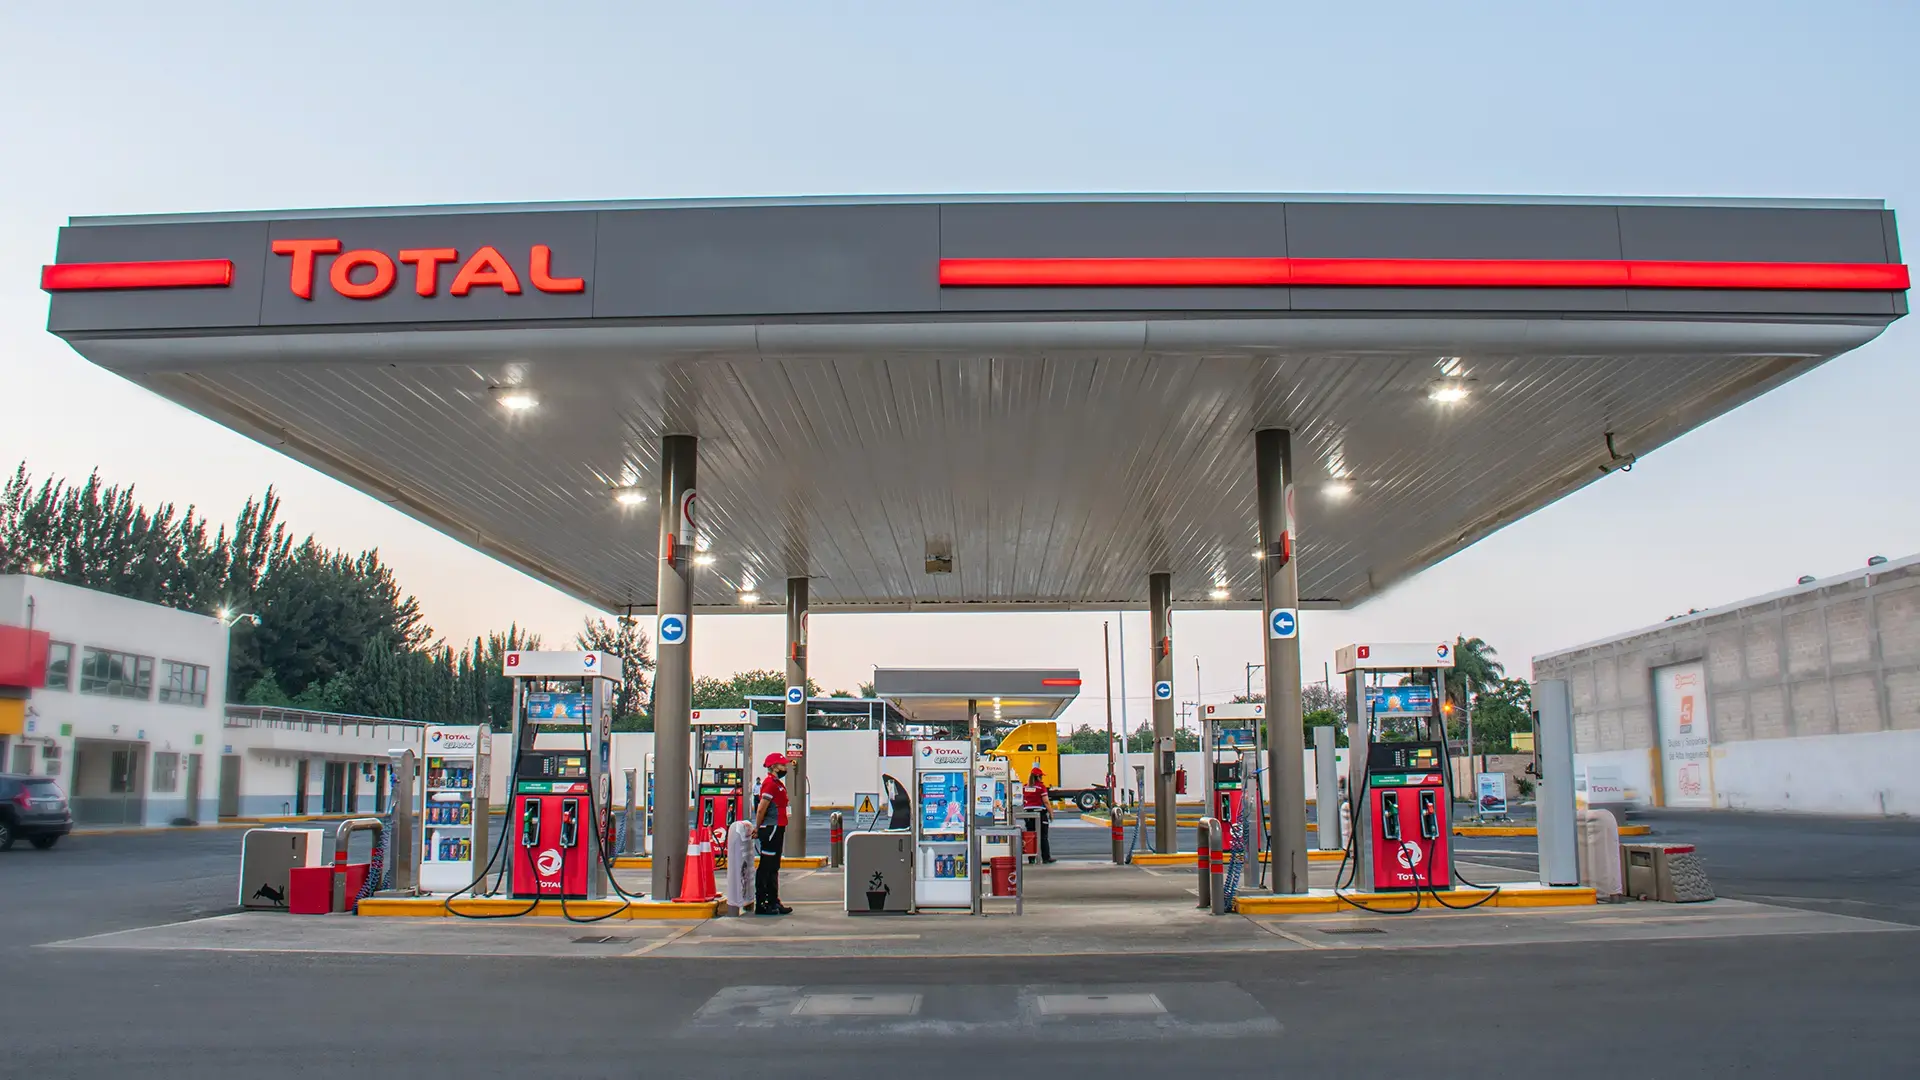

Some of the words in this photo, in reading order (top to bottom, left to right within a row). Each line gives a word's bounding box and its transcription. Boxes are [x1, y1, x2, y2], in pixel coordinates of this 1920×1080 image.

[272, 238, 585, 301] TOTAL
[1360, 649, 1366, 657] 1
[510, 657, 516, 665] 3
[934, 756, 968, 765] QUARTZ
[1591, 785, 1621, 793] TOTAL
